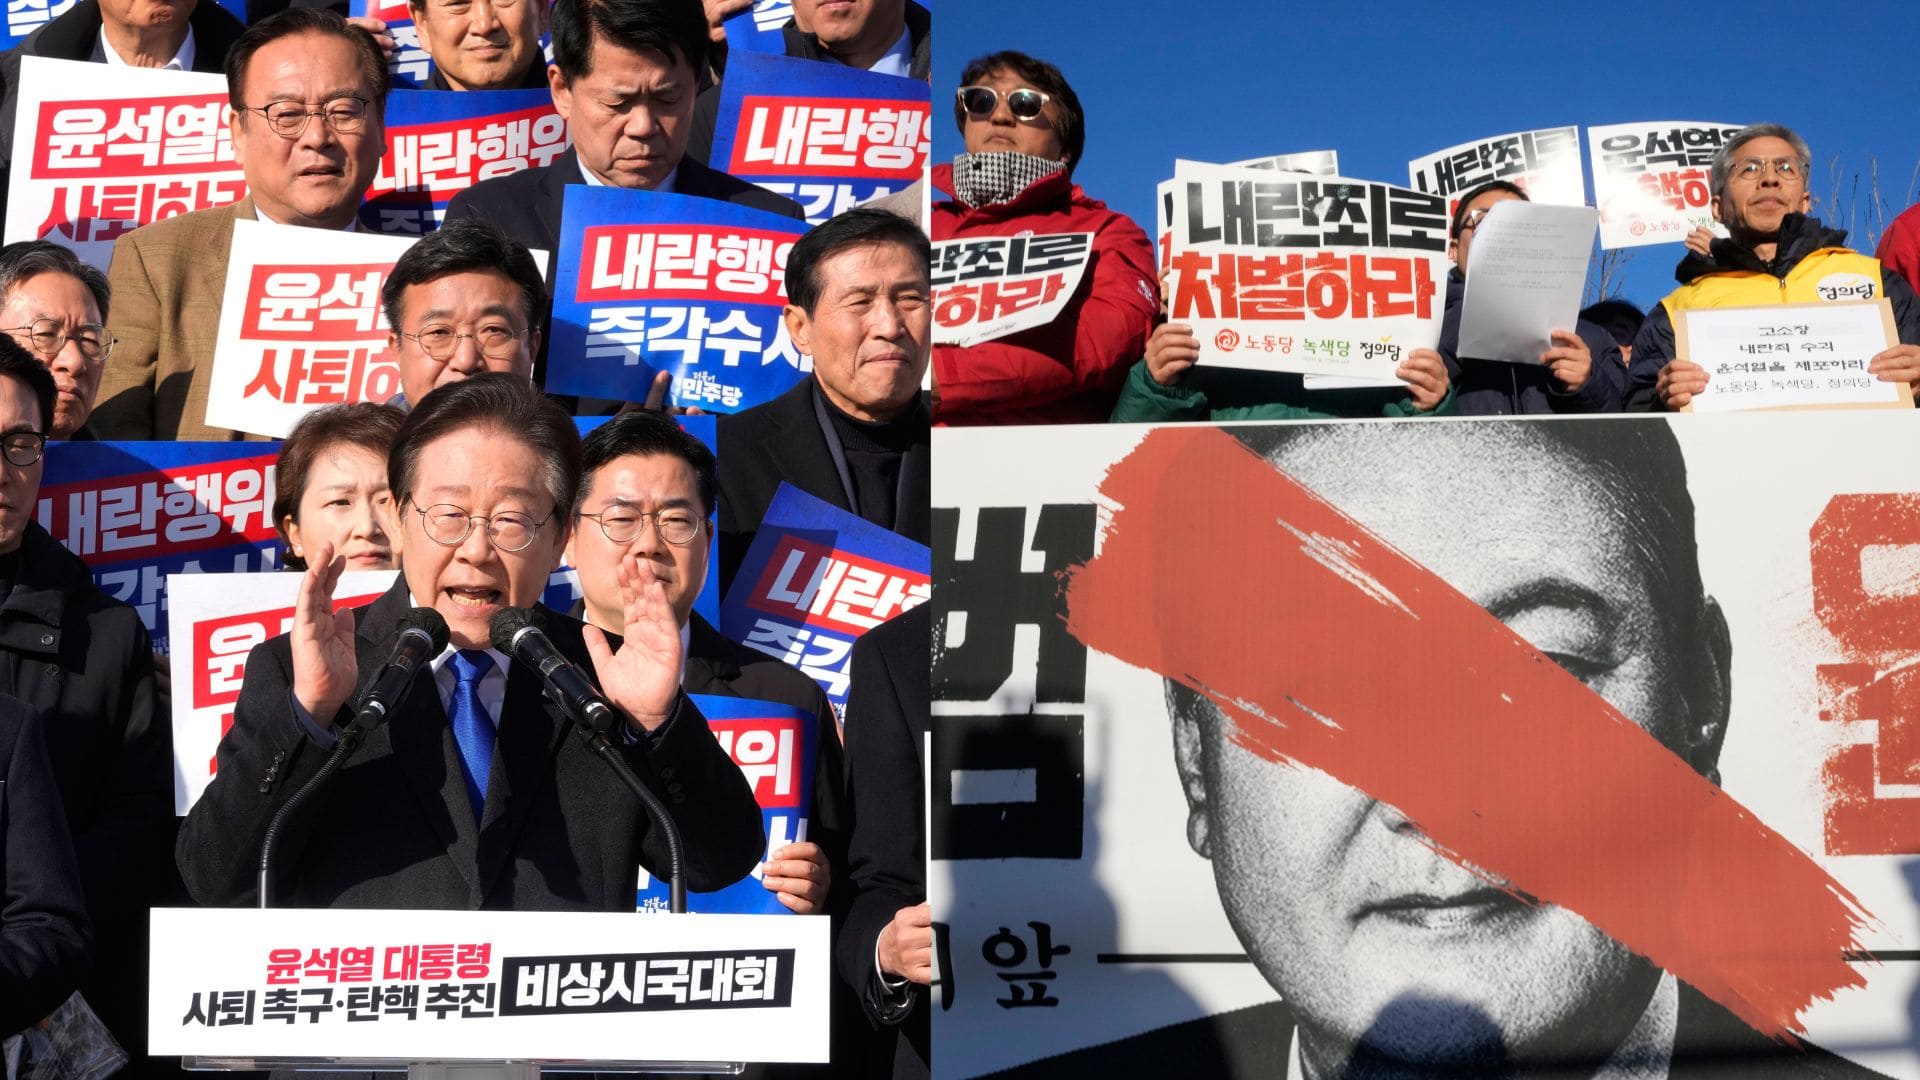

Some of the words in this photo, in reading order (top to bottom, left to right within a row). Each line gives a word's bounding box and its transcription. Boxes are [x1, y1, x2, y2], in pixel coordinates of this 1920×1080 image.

[744, 106, 931, 169] 내란행
[37, 179, 247, 241] 사퇴하
[1187, 181, 1447, 252] 내란죄로
[257, 272, 395, 332] 윤석
[931, 272, 1066, 328] 하라
[1171, 251, 1436, 321] 처벌하라
[1818, 283, 1875, 300] 정의당
[1244, 335, 1294, 354] 노동당
[1303, 338, 1351, 357] 녹색당
[1359, 342, 1402, 361] 정의당
[1740, 342, 1790, 354] 내란죄
[1801, 341, 1834, 352] 수괴
[1758, 325, 1809, 336] 고소장
[1716, 361, 1785, 374] 윤석열을
[1795, 359, 1865, 371] 체포하라
[1828, 377, 1871, 388] 정의당
[682, 378, 743, 407] 민주당
[266, 946, 374, 985] 윤석열
[383, 943, 492, 981] 대통령
[515, 955, 778, 1008] 비상시국대회
[982, 921, 1071, 1009] 앞
[182, 989, 256, 1027] 사퇴
[424, 982, 496, 1020] 추진
